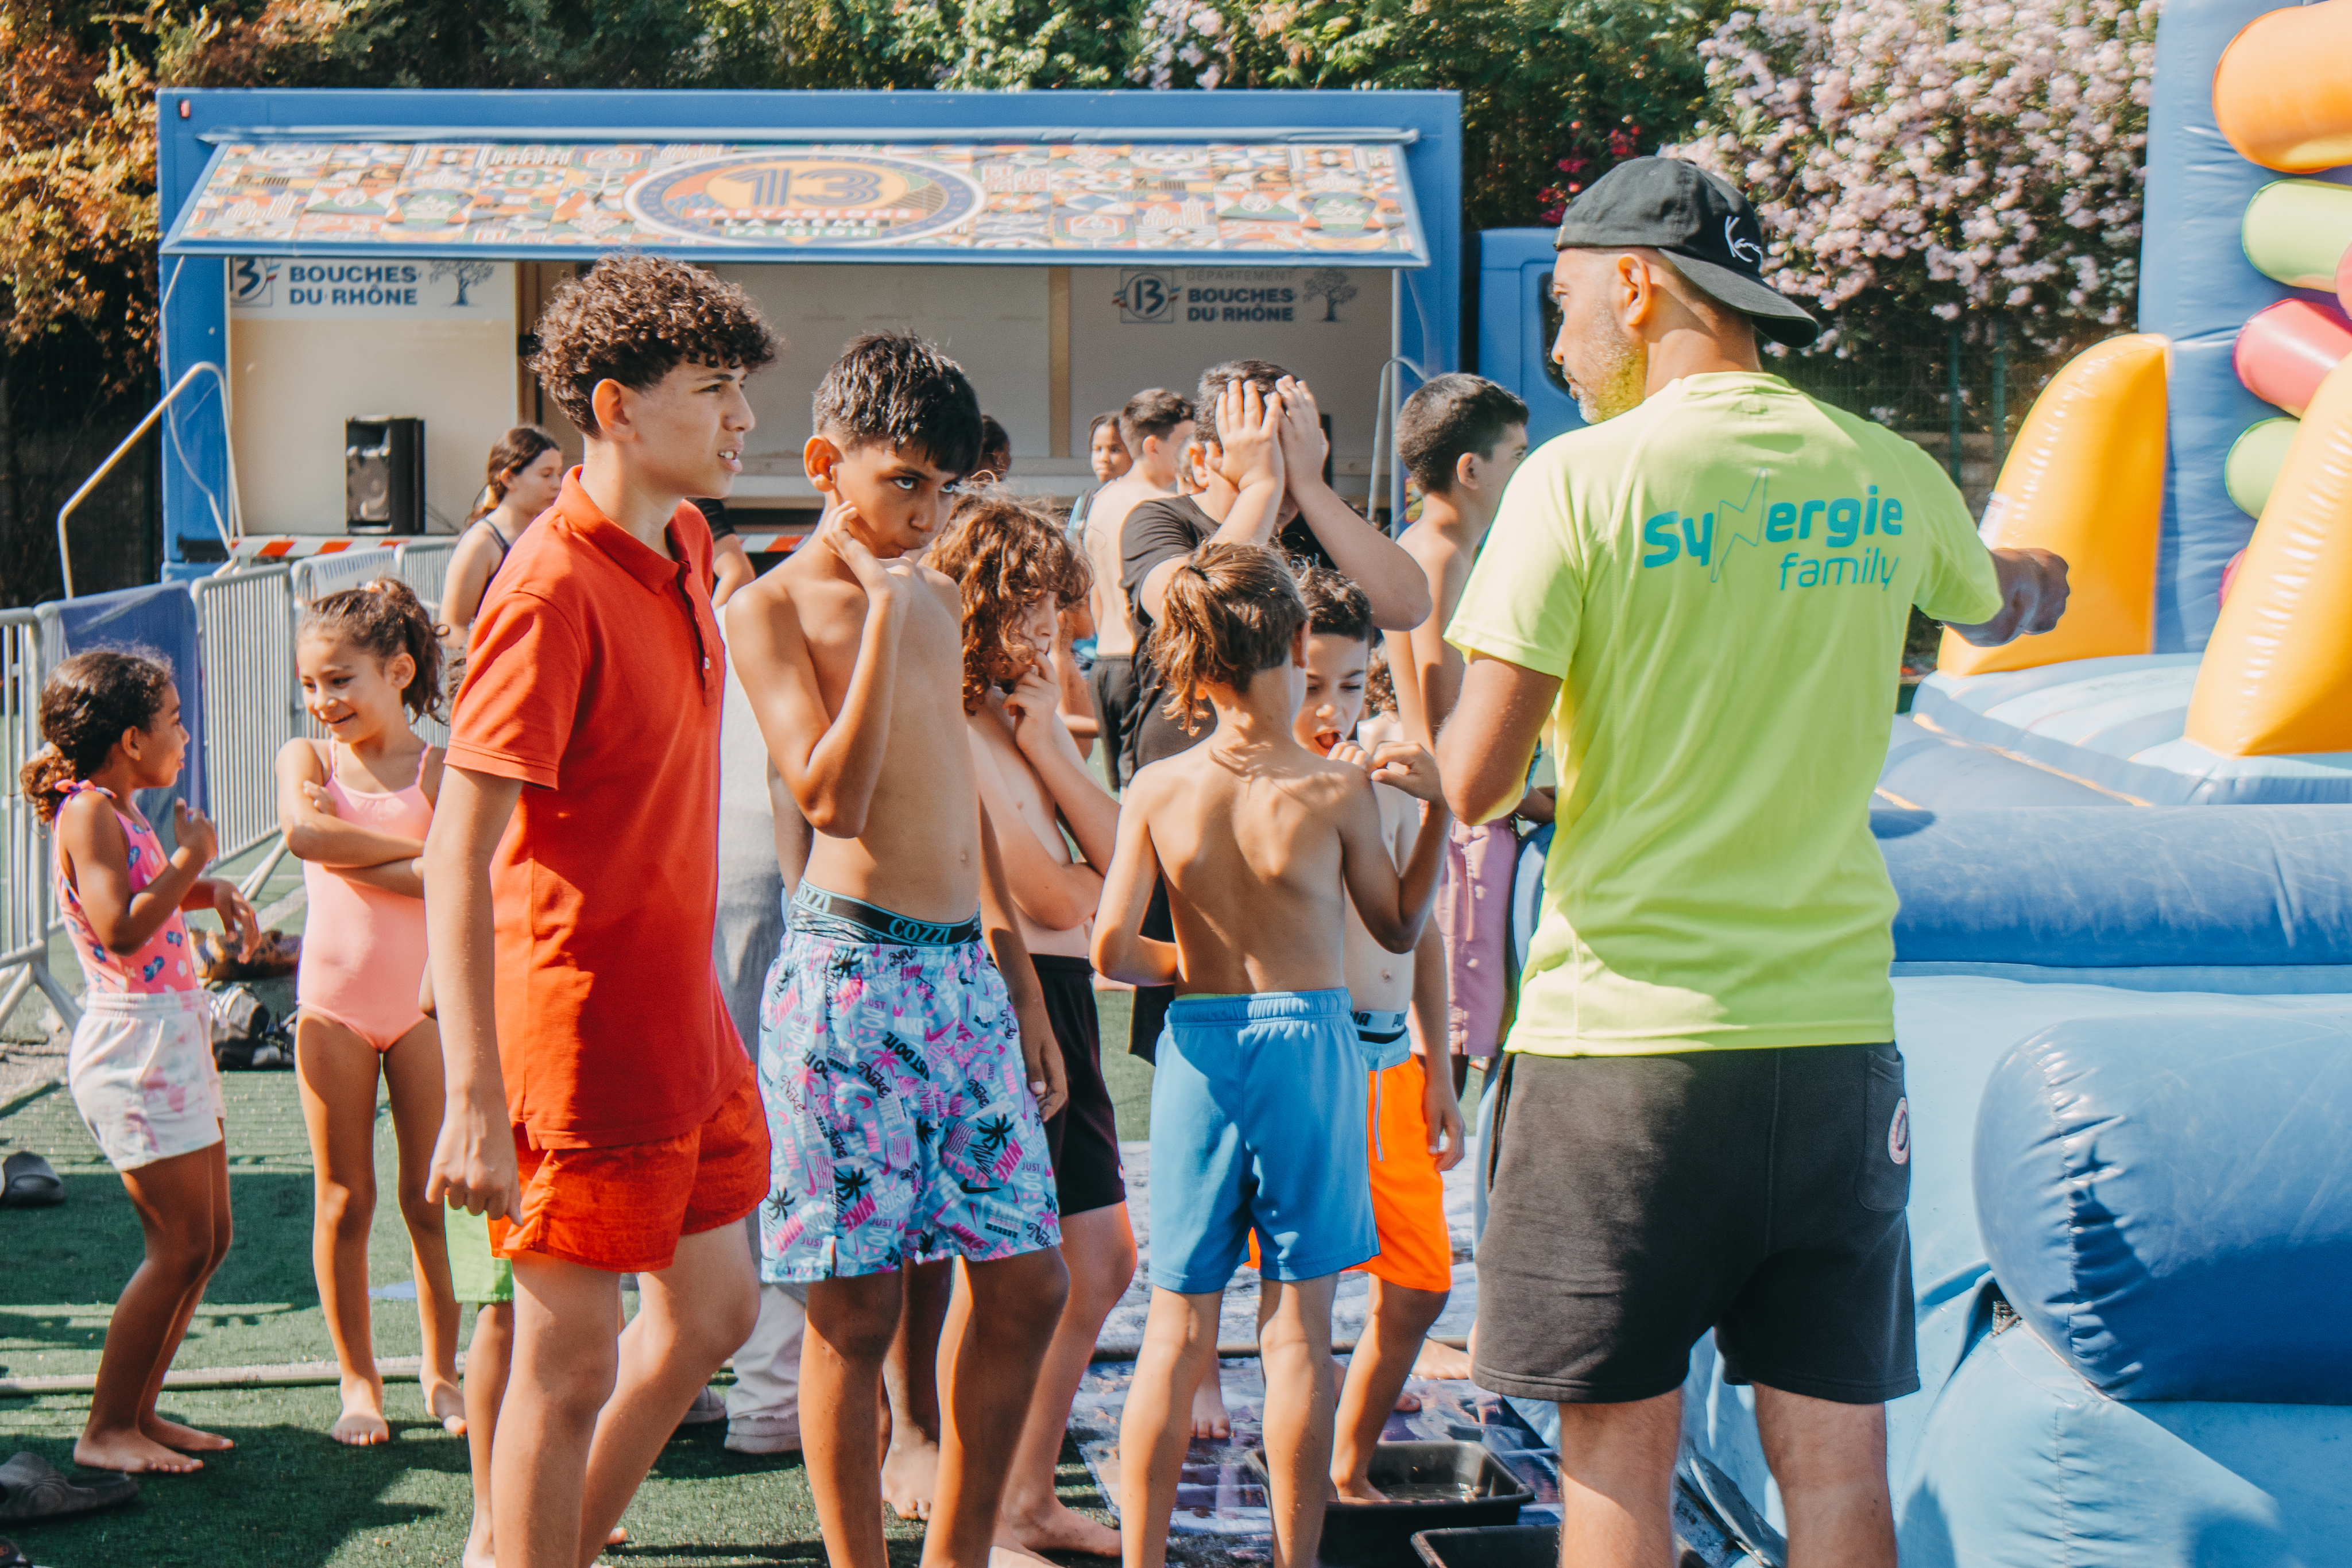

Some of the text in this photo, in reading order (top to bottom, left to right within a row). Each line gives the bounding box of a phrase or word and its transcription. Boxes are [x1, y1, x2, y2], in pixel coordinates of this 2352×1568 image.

[722, 168, 882, 207] 13
[693, 208, 911, 219] PARTAGEONS
[724, 218, 765, 227] LA
[729, 226, 871, 237] PASSION
[1135, 280, 1165, 313] 13
[1780, 547, 1899, 591] family
[864, 997, 887, 1010] JUST
[857, 1061, 892, 1099] Nike
[967, 1079, 990, 1109] Nike
[1001, 1061, 1019, 1095] NIKE
[780, 1075, 806, 1116] Nike
[862, 1120, 881, 1153] NIKE
[782, 1137, 802, 1170] NIKE
[992, 1137, 1024, 1185] NIKE
[1021, 1163, 1040, 1172] JUST
[841, 1192, 877, 1234] NIKE
[870, 1218, 893, 1228] JUST
[1026, 1222, 1053, 1248] Nik
